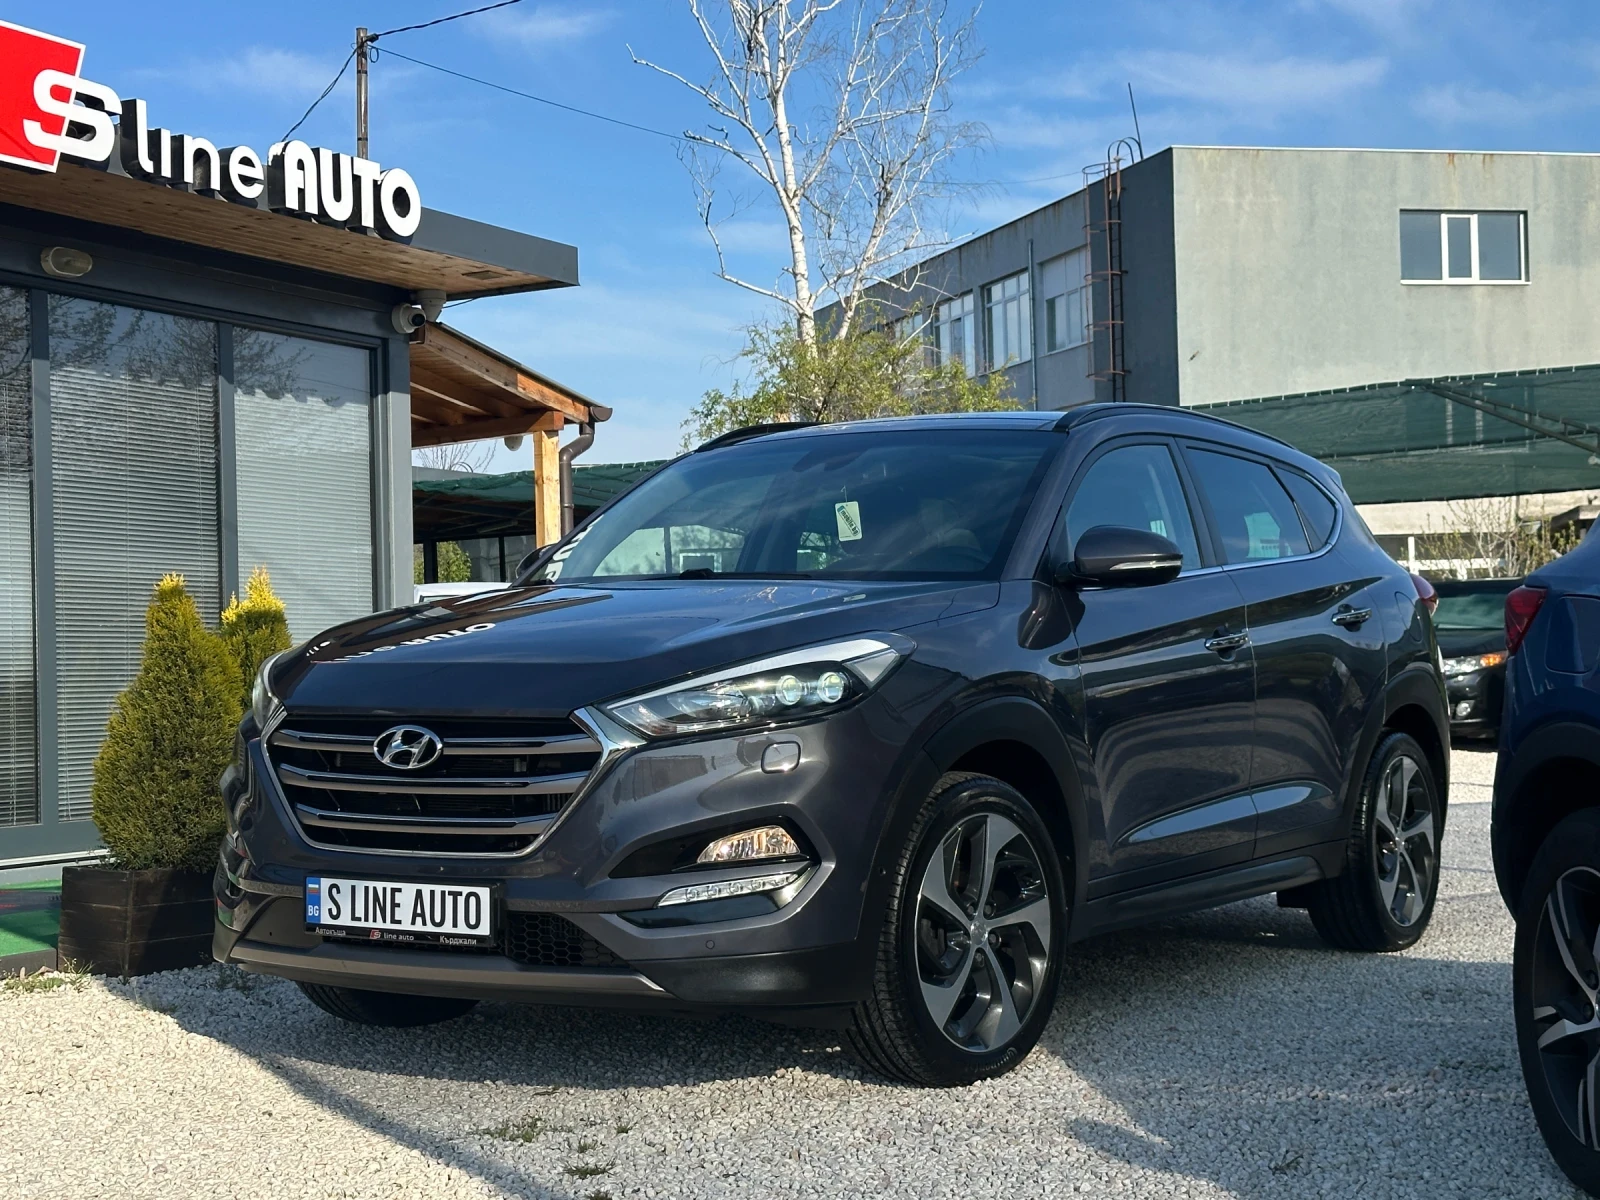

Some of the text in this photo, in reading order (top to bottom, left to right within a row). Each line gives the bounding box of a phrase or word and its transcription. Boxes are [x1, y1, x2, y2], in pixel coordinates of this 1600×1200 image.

[23, 69, 122, 162] S
[284, 139, 421, 237] AUTO
[308, 905, 319, 917] BG
[327, 883, 482, 930] S LINE AUTO
[315, 926, 346, 936] Автокъща
[383, 932, 397, 940] line
[439, 935, 477, 945] Кърджали
